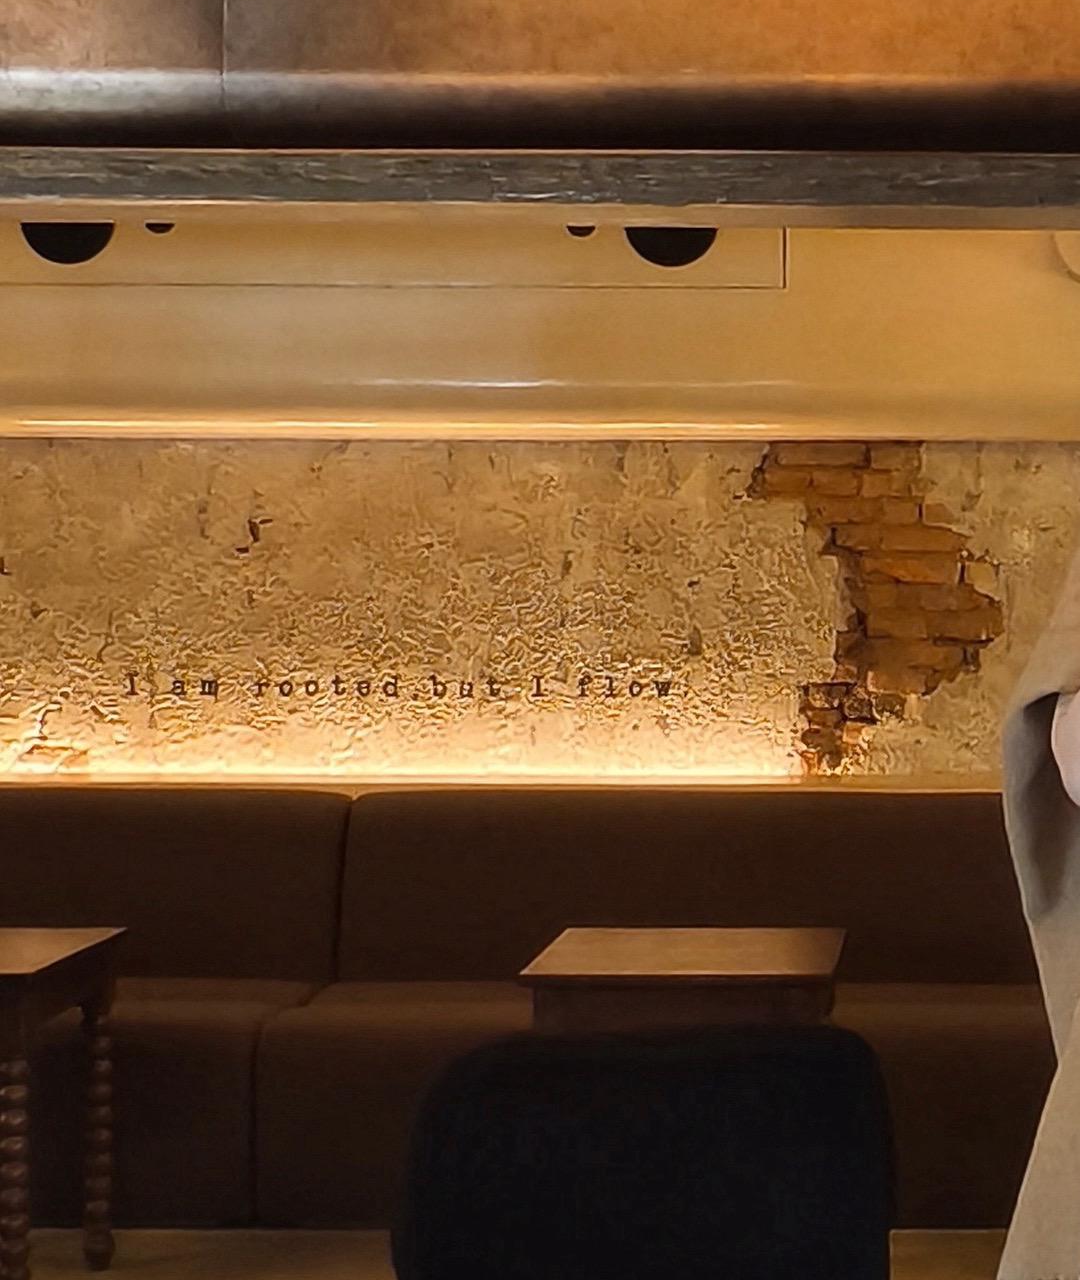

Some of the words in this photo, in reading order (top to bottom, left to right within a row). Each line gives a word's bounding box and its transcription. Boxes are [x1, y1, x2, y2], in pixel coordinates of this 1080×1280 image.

[126, 671, 139, 696] I
[171, 677, 218, 697] am
[428, 674, 502, 699] but
[530, 674, 547, 697] I
